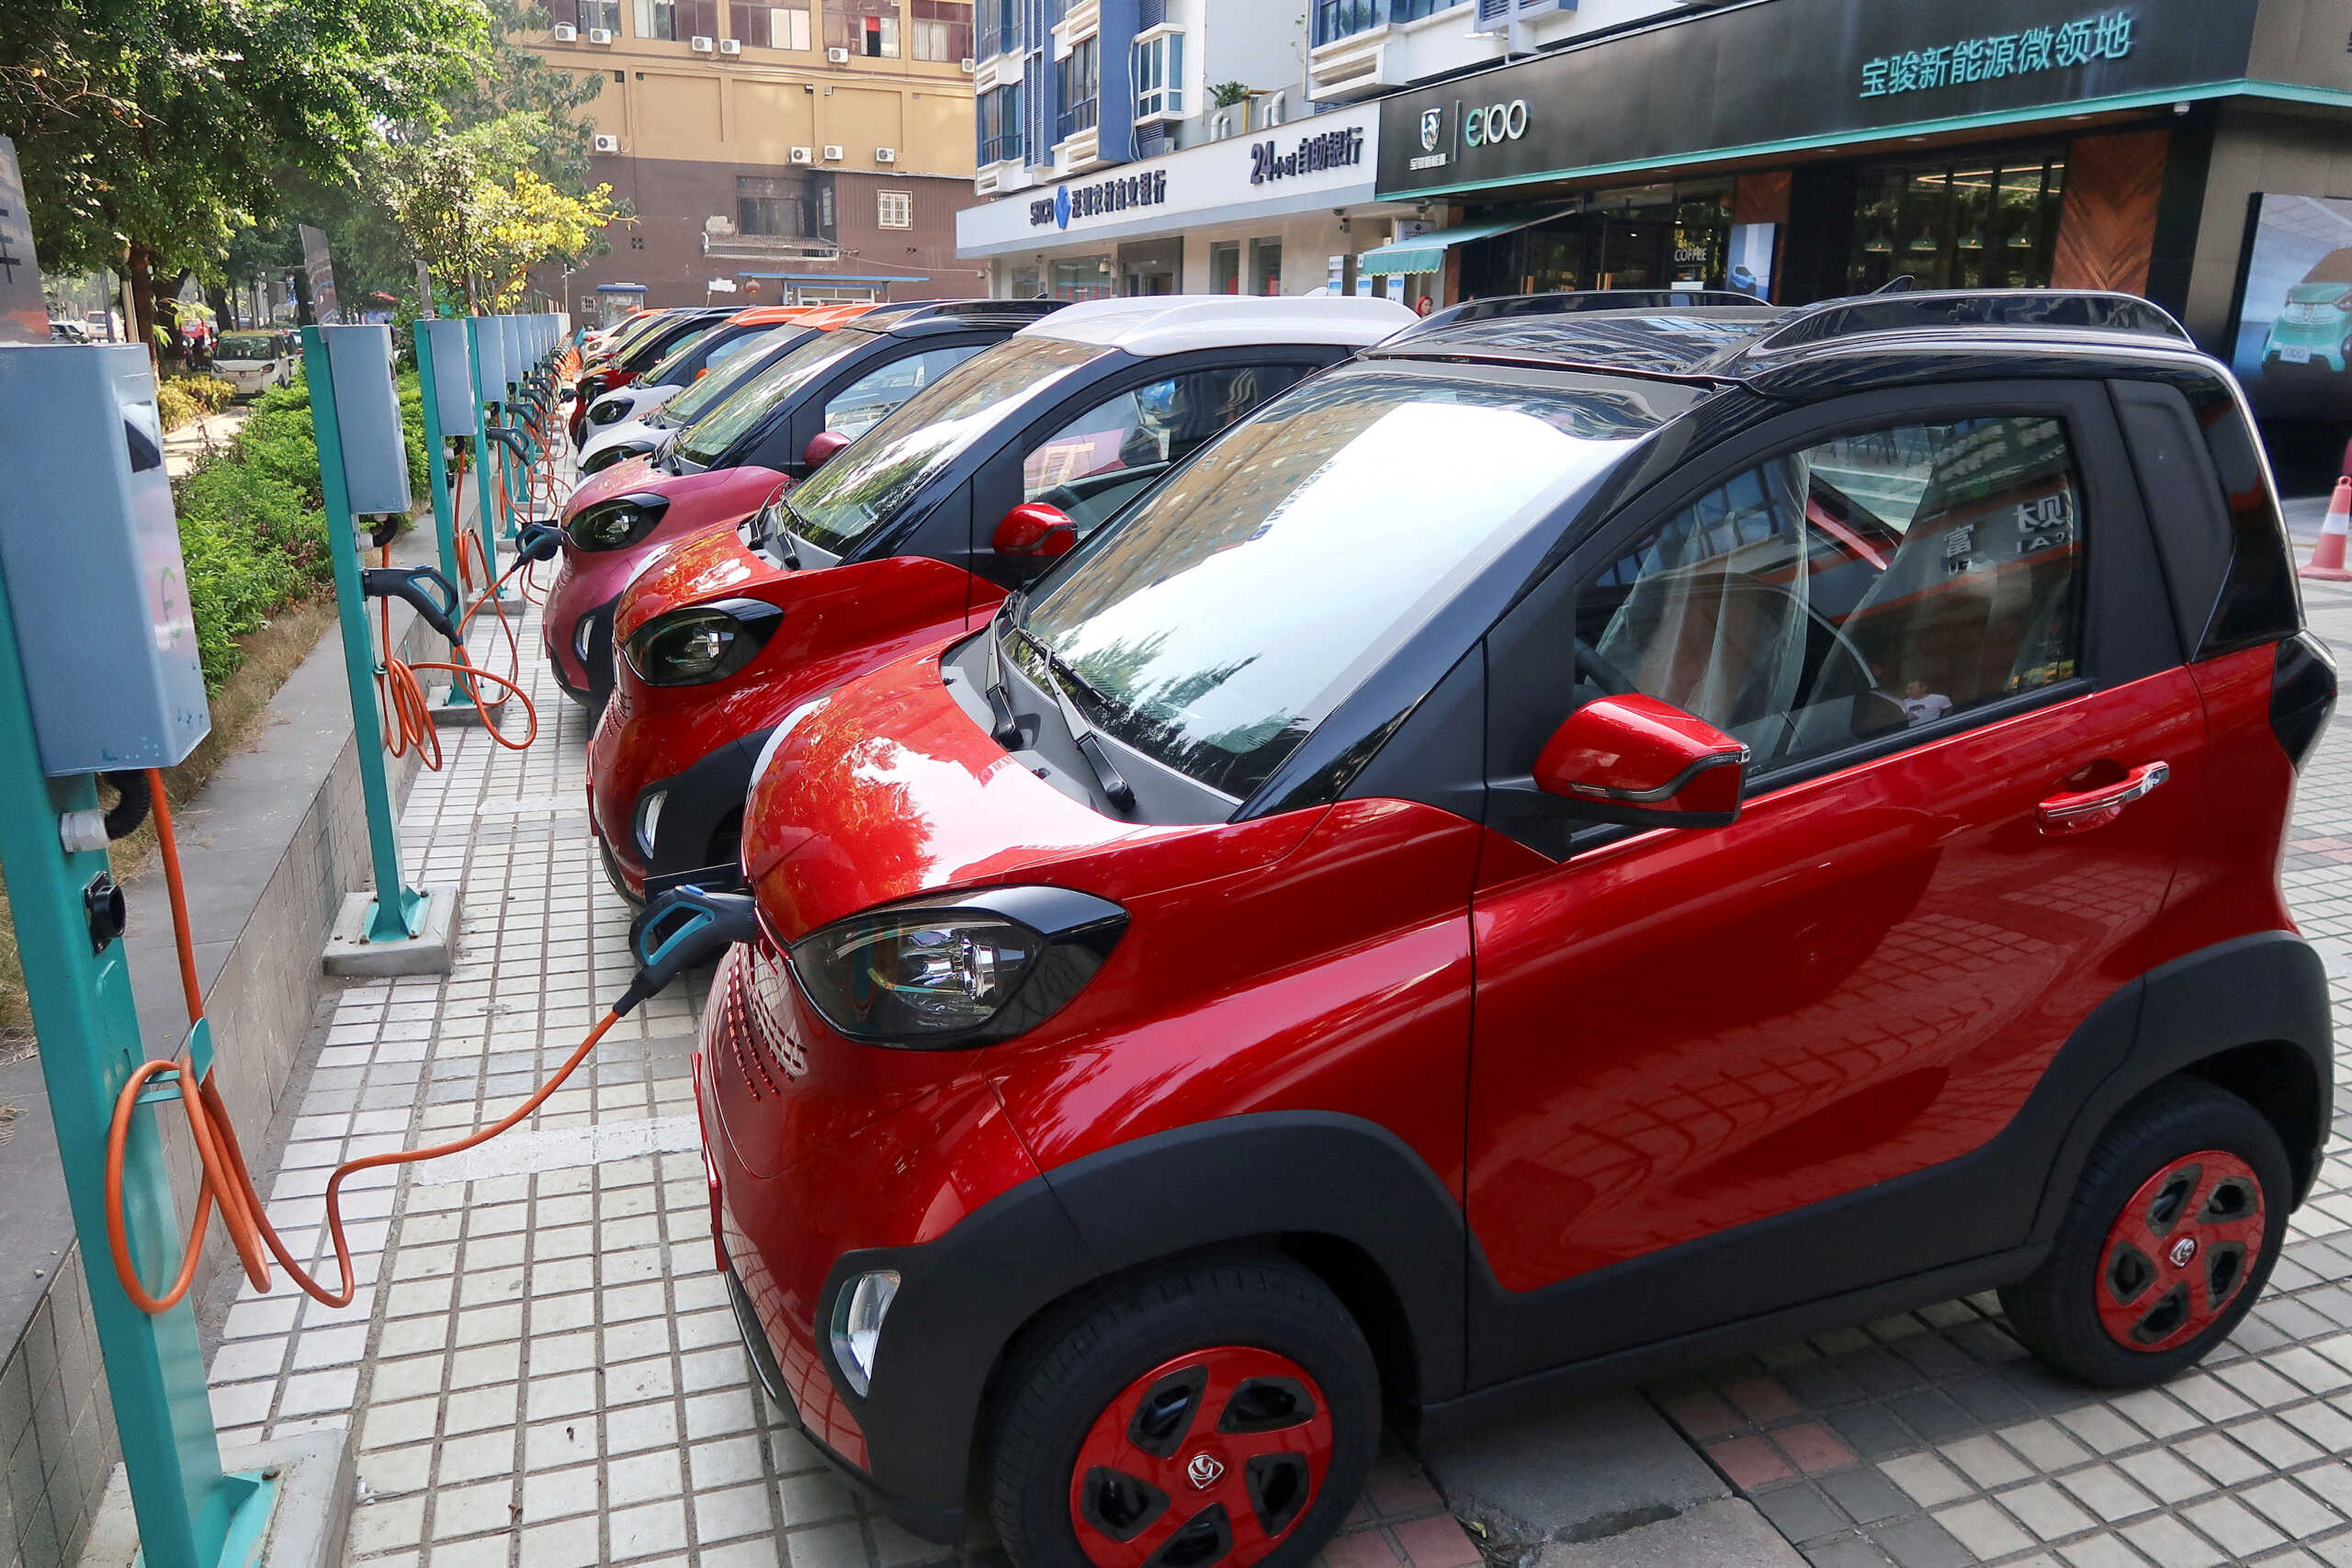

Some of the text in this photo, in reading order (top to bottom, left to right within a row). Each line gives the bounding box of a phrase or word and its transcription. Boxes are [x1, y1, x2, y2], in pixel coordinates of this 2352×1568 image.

[1860, 11, 2132, 98] 宝骏新能源微领地
[1675, 247, 1708, 262] COFFEE
